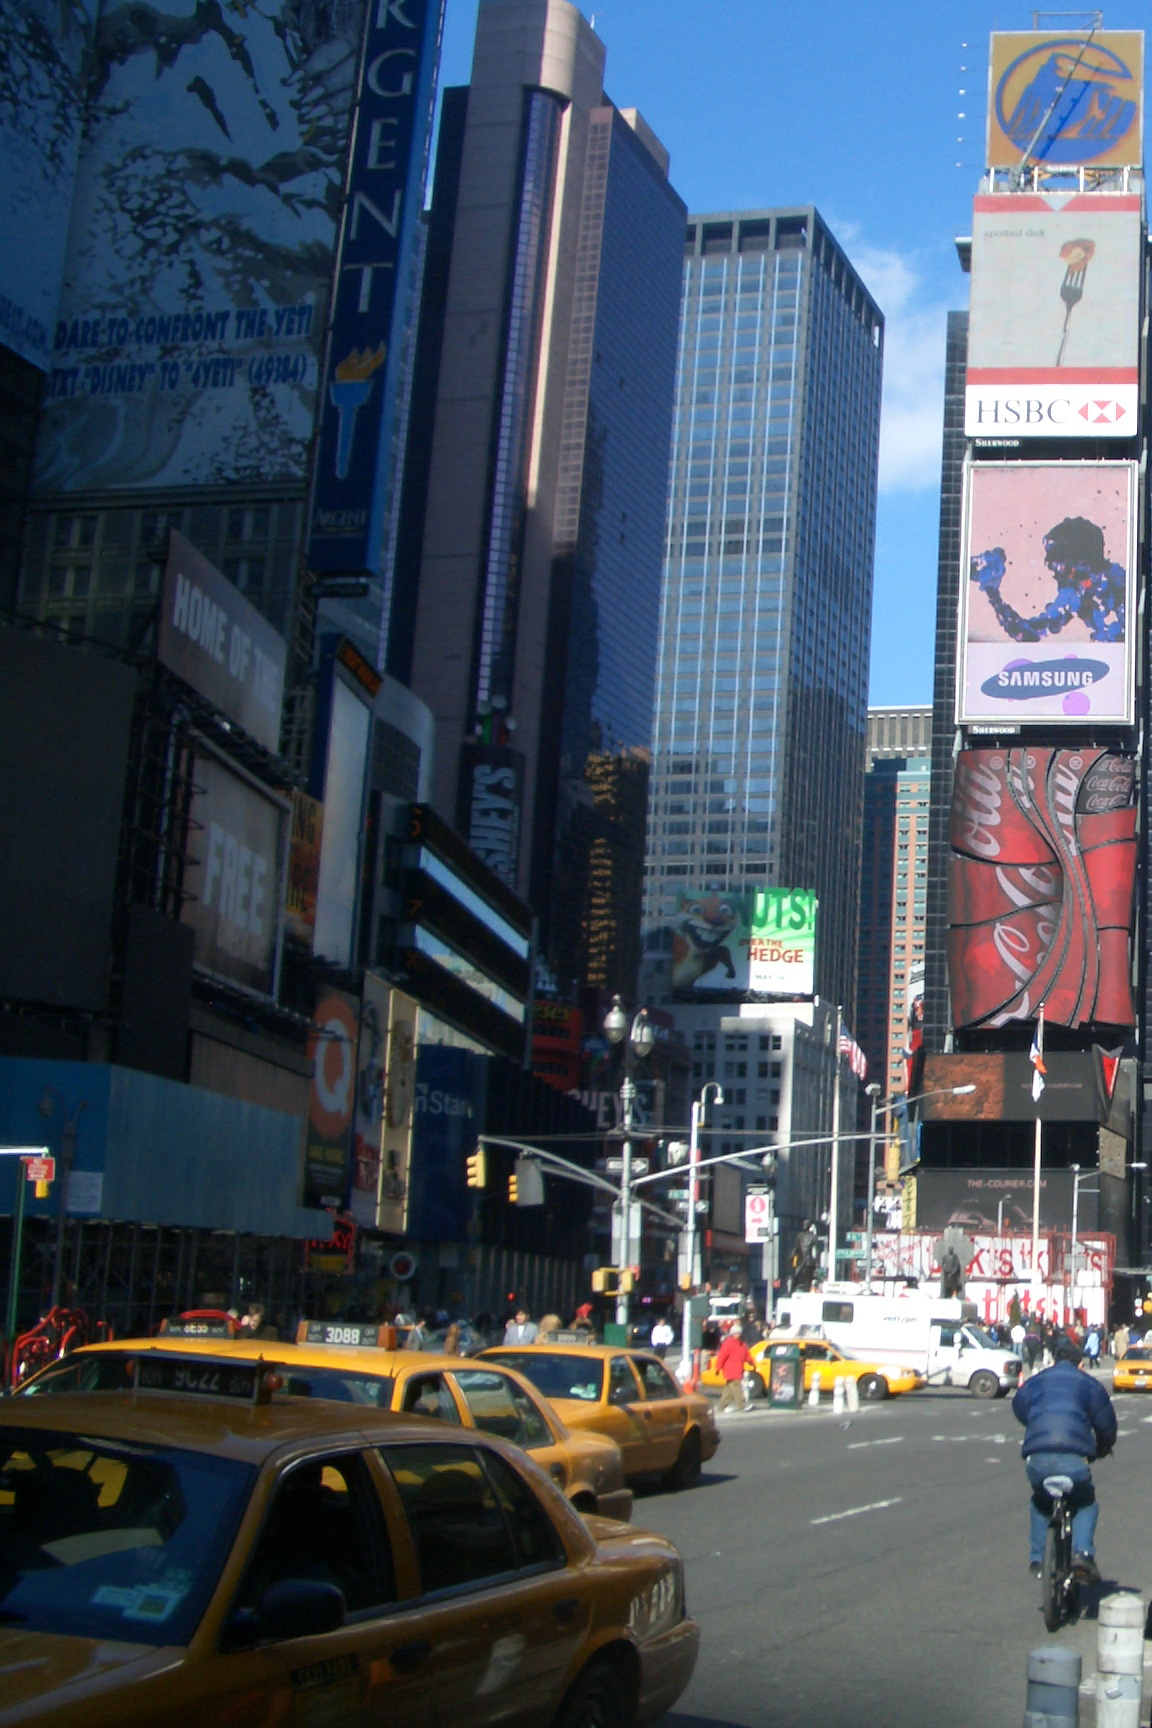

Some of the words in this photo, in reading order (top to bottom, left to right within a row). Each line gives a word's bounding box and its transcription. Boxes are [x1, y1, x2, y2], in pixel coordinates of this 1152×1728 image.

[984, 228, 1022, 238] spotted
[54, 318, 99, 351] DARE
[107, 317, 130, 346] TO
[135, 310, 230, 345] CONFRONT
[235, 307, 268, 339] THE
[274, 303, 314, 337] YETI
[160, 361, 181, 391] TO
[976, 398, 1071, 425] HSBC
[173, 572, 229, 666] HOME
[228, 623, 252, 683] OF
[997, 671, 1094, 688] SAMSUNG
[204, 821, 268, 937] FREE
[766, 938, 783, 949] THE
[747, 948, 804, 964] HEDGE
[325, 1326, 361, 1345] 3D88
